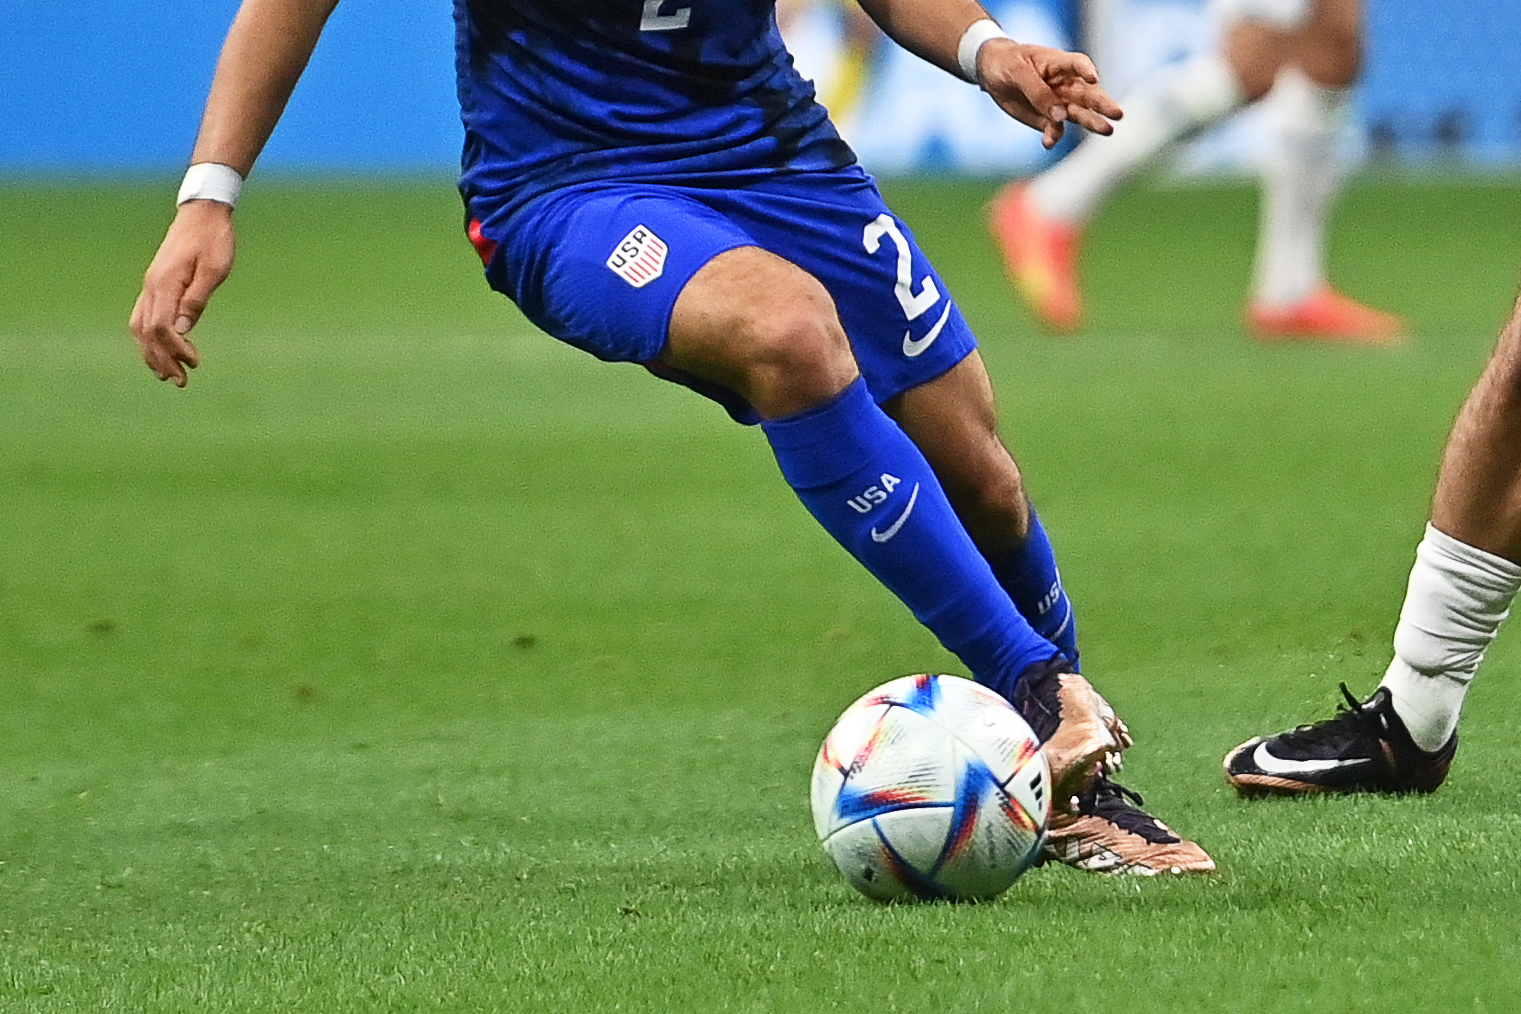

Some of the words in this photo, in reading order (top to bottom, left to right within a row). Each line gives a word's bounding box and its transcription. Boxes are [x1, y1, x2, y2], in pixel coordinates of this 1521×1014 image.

[611, 229, 647, 269] USA
[862, 213, 941, 321] 2
[846, 472, 902, 514] USA
